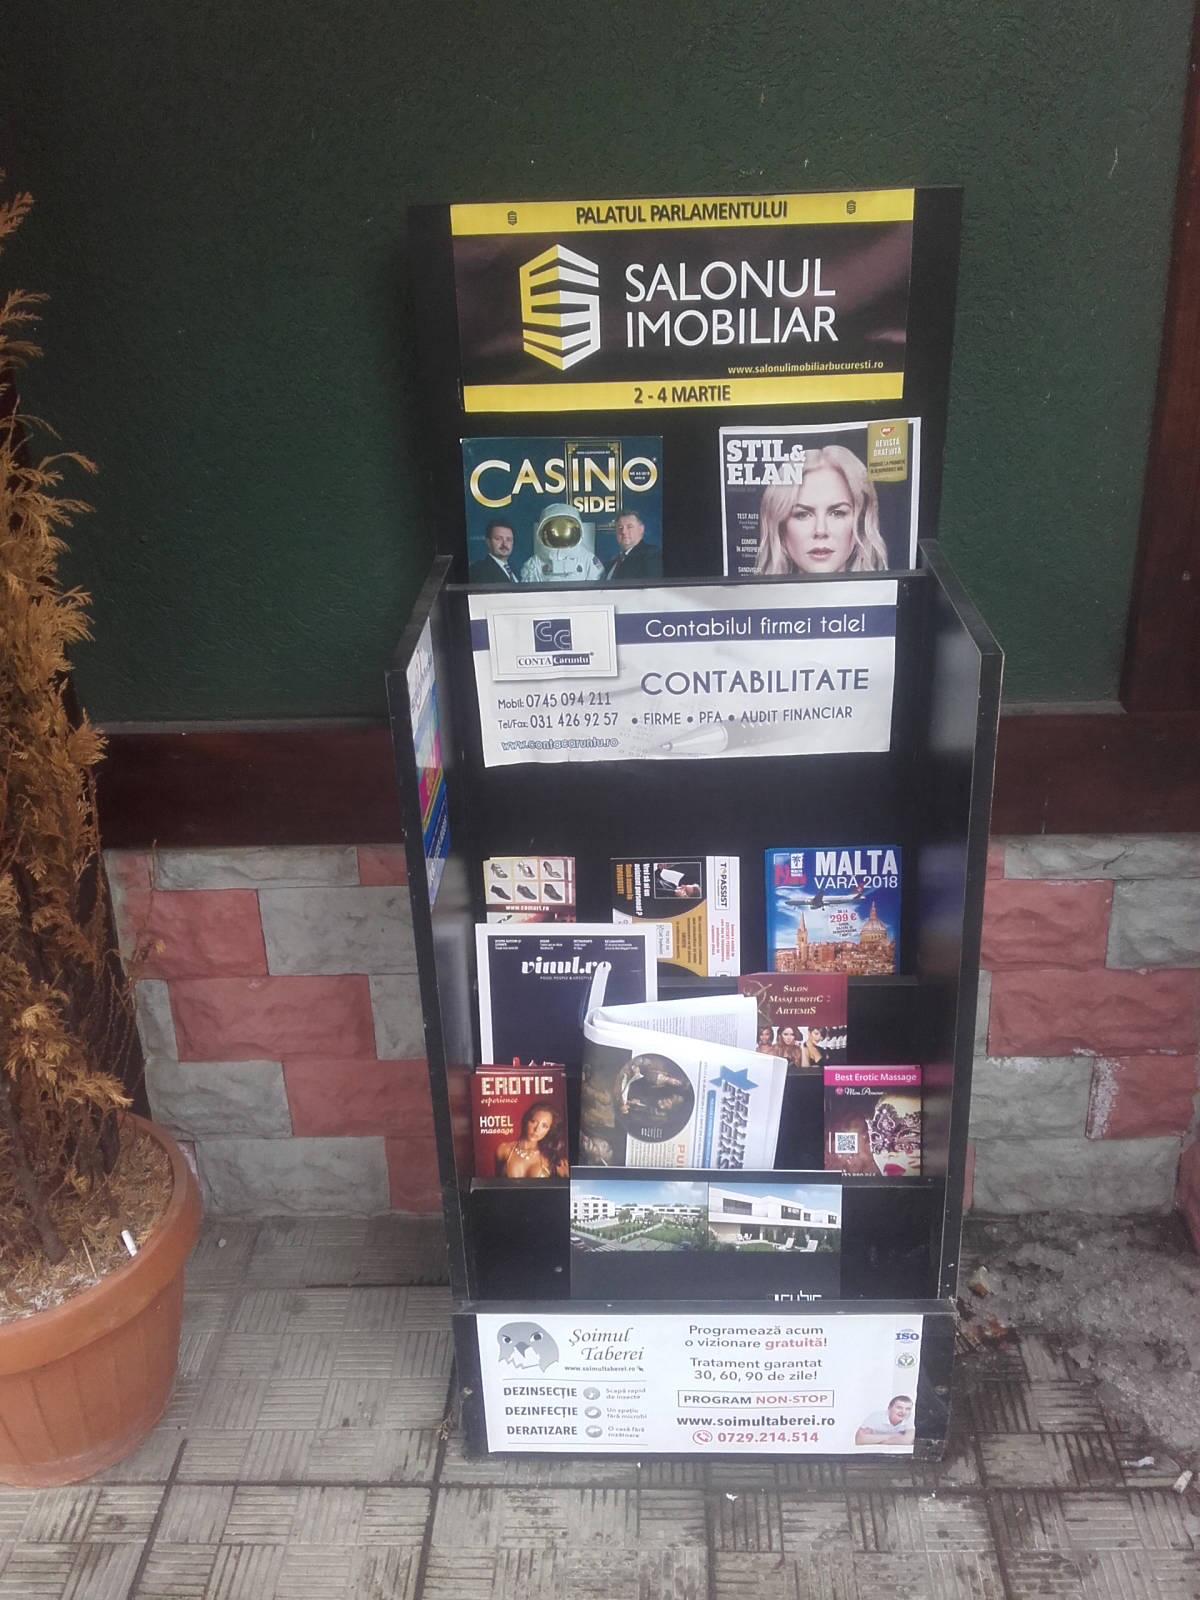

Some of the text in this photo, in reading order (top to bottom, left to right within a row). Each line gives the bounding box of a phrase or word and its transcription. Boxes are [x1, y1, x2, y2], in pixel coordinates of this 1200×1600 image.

[576, 200, 788, 224] PALATUL PARLAMENTULUI
[625, 257, 836, 303] SALONUL
[626, 306, 839, 348] IMOBILIAR
[728, 360, 884, 375] www.salonulimobiliarbucuresti.ro
[633, 387, 643, 404] 2
[656, 388, 668, 404] 4
[671, 385, 732, 403] MARTIE
[727, 439, 806, 462] STIL&
[727, 463, 805, 485] ELAN
[470, 456, 658, 508] CASINO
[573, 496, 616, 513] SIDE
[646, 613, 867, 638] Contabilul firmei tale!
[518, 656, 552, 666] CONTA
[640, 668, 870, 697] CONTABILITATE
[526, 693, 558, 708] 0745
[560, 692, 584, 706] 094
[588, 691, 612, 706] 211
[530, 714, 553, 729] 031
[558, 713, 581, 727] 426
[584, 712, 599, 727] 92
[603, 712, 618, 726] 57
[643, 705, 853, 726] FIRME PFA AUDIT FINANCIAR
[501, 737, 619, 751] www.contacaruntu.ro
[815, 849, 899, 876] MALTA
[863, 875, 898, 889] 2018
[830, 913, 849, 923] 299
[522, 956, 611, 975] vinul.ro
[835, 1073, 917, 1082] Best Erotic Massage
[481, 1076, 553, 1096] EROTIC
[481, 1096, 519, 1107] experience
[480, 1115, 514, 1128] HOTEL
[676, 1143, 686, 1168] PU
[689, 1325, 823, 1337] Programează acum
[895, 1333, 920, 1341] ISO
[684, 1337, 827, 1350] o vizionare gratuită!
[580, 1346, 645, 1361] Taberei
[564, 1365, 636, 1373] www.soimultaberei.ro
[690, 1357, 822, 1370] Tratament garantat
[694, 1370, 818, 1382] 30, 60, 90 de zile!
[683, 1393, 828, 1405] PROGRAM NON-STOP
[677, 1415, 835, 1427] www.soimultaberei.ro
[506, 1425, 578, 1436] DERATIZARE
[717, 1432, 819, 1443] 0729.214.514
